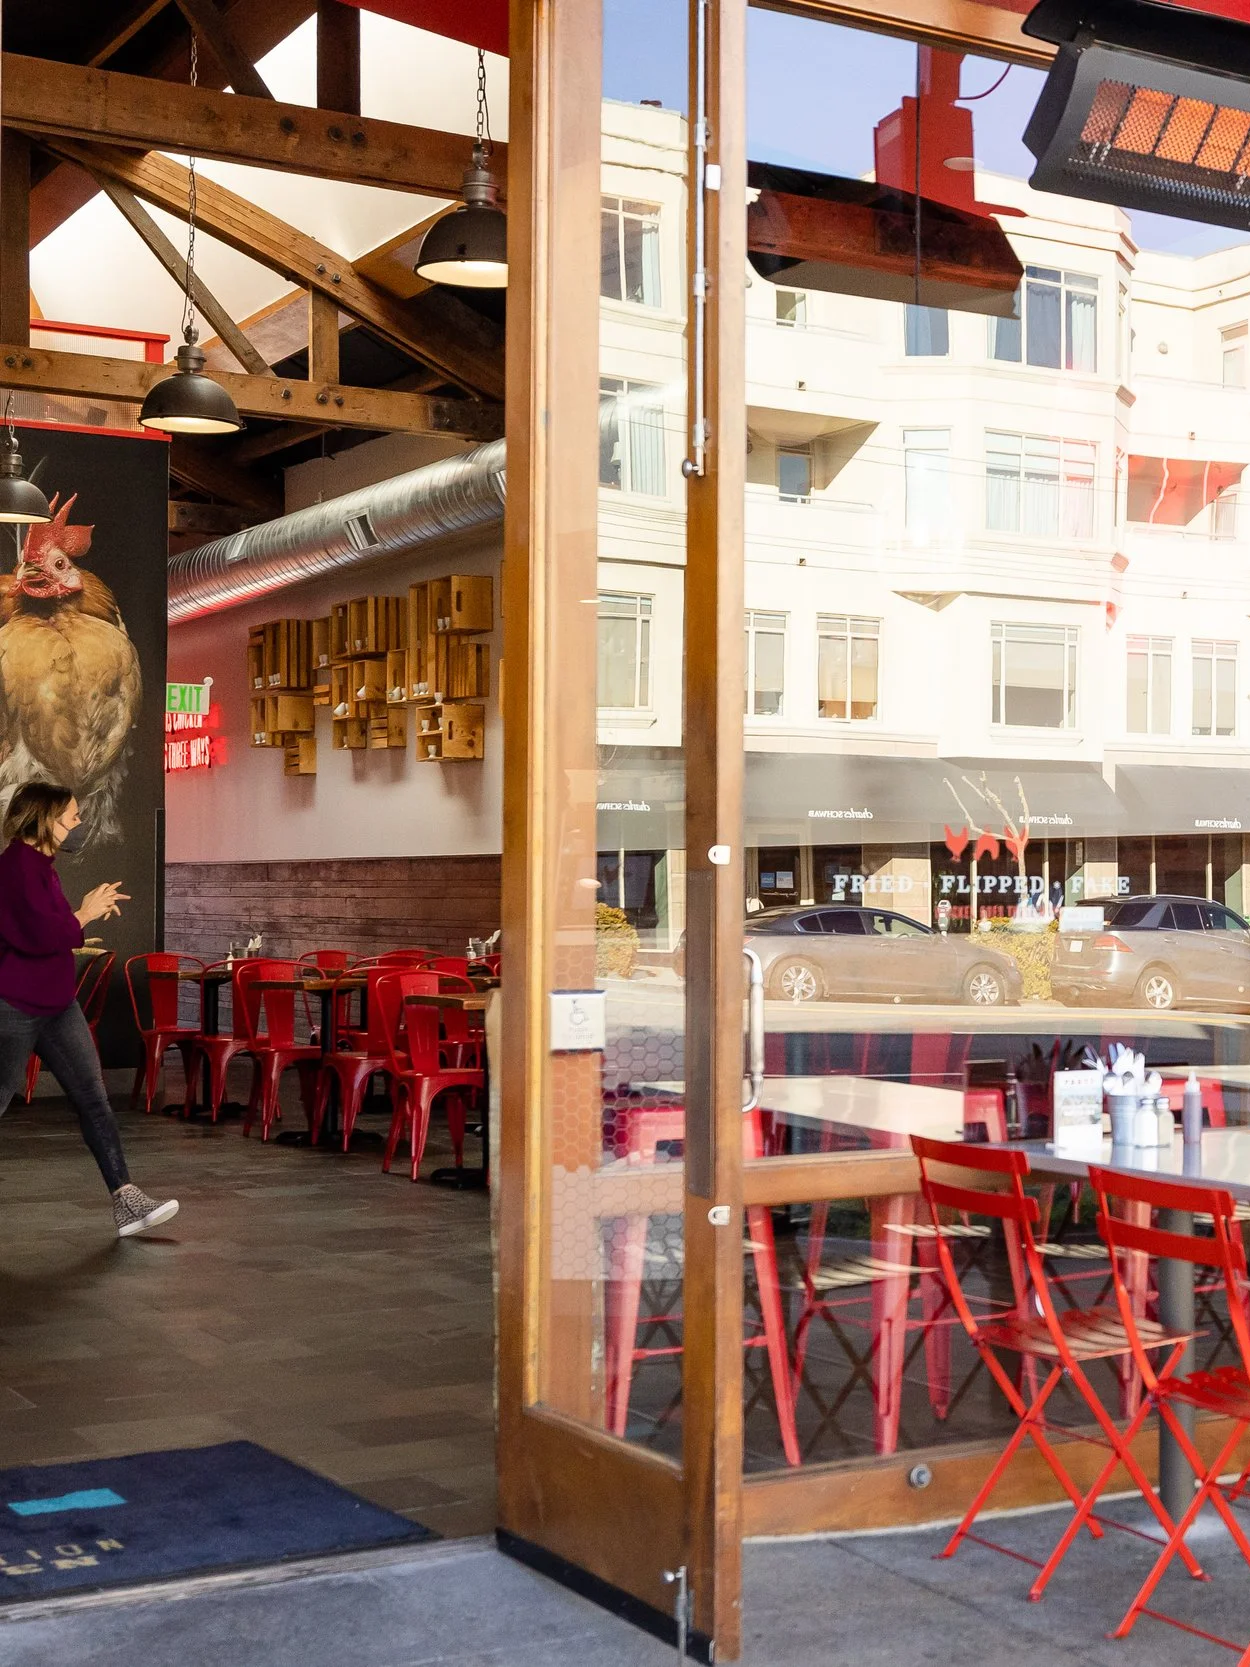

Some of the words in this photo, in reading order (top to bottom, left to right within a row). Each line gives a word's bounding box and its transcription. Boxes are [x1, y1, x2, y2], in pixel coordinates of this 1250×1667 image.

[167, 685, 203, 712] EXIT
[168, 740, 189, 769] THREE
[190, 735, 210, 767] WAYS
[832, 874, 914, 894] FRIED
[940, 875, 1044, 894] FLIPPED
[1070, 876, 1131, 894] FAKE
